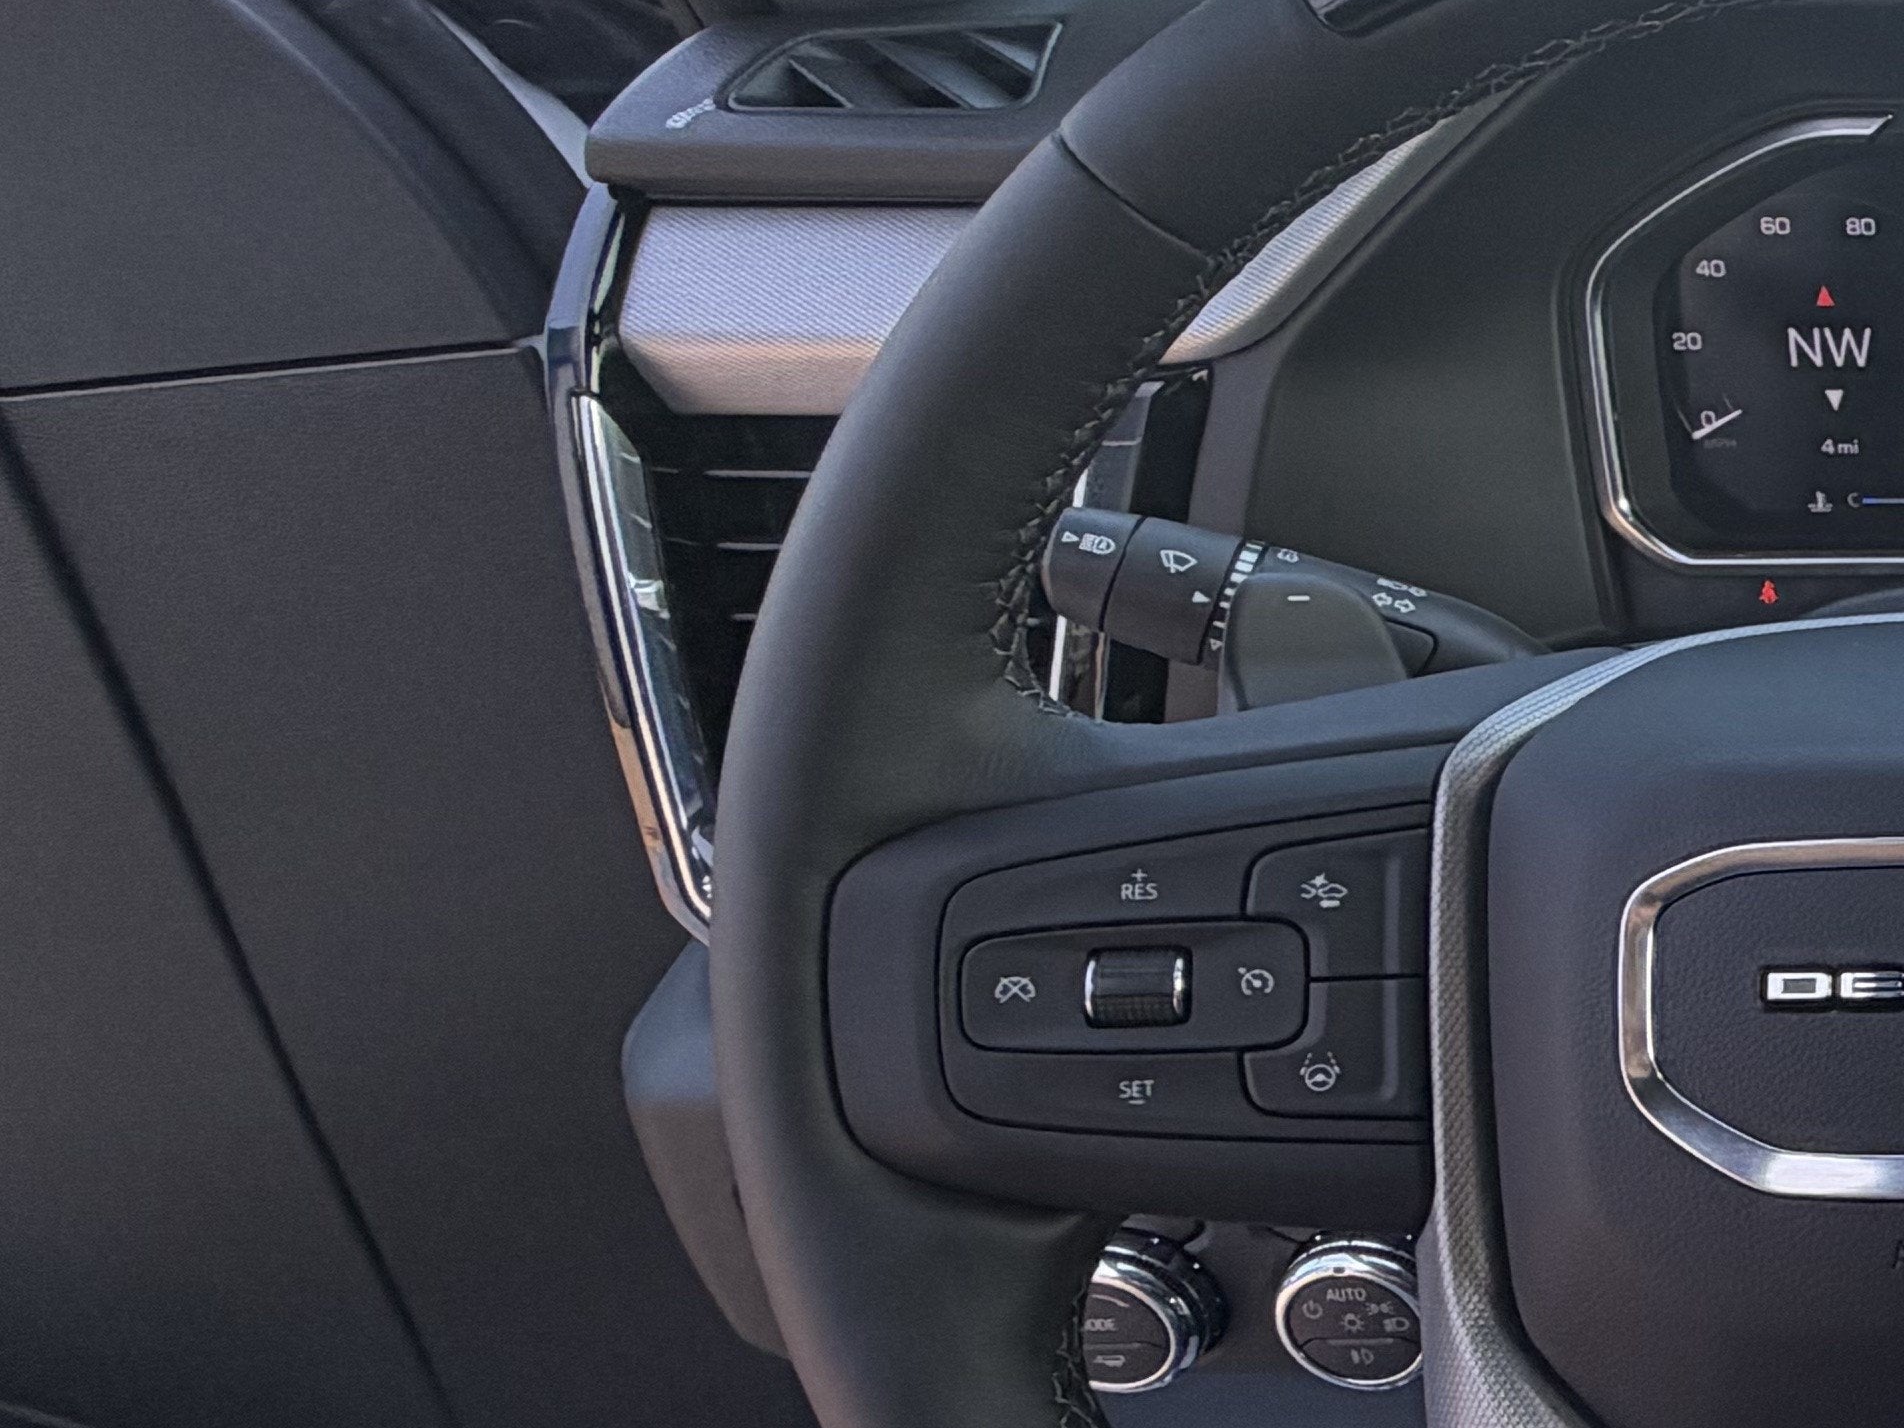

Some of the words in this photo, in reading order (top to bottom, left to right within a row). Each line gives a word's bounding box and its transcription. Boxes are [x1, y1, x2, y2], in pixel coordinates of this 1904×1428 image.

[1760, 216, 1791, 235] 60
[1845, 217, 1876, 236] 80
[1695, 259, 1727, 278] 40
[1671, 332, 1702, 351] 20
[1786, 327, 1872, 368] NW
[1821, 438, 1835, 454] 4
[1837, 438, 1860, 454] mi
[1120, 881, 1158, 902] RES
[1118, 1079, 1155, 1100] SET
[1325, 1287, 1367, 1303] AUTO
